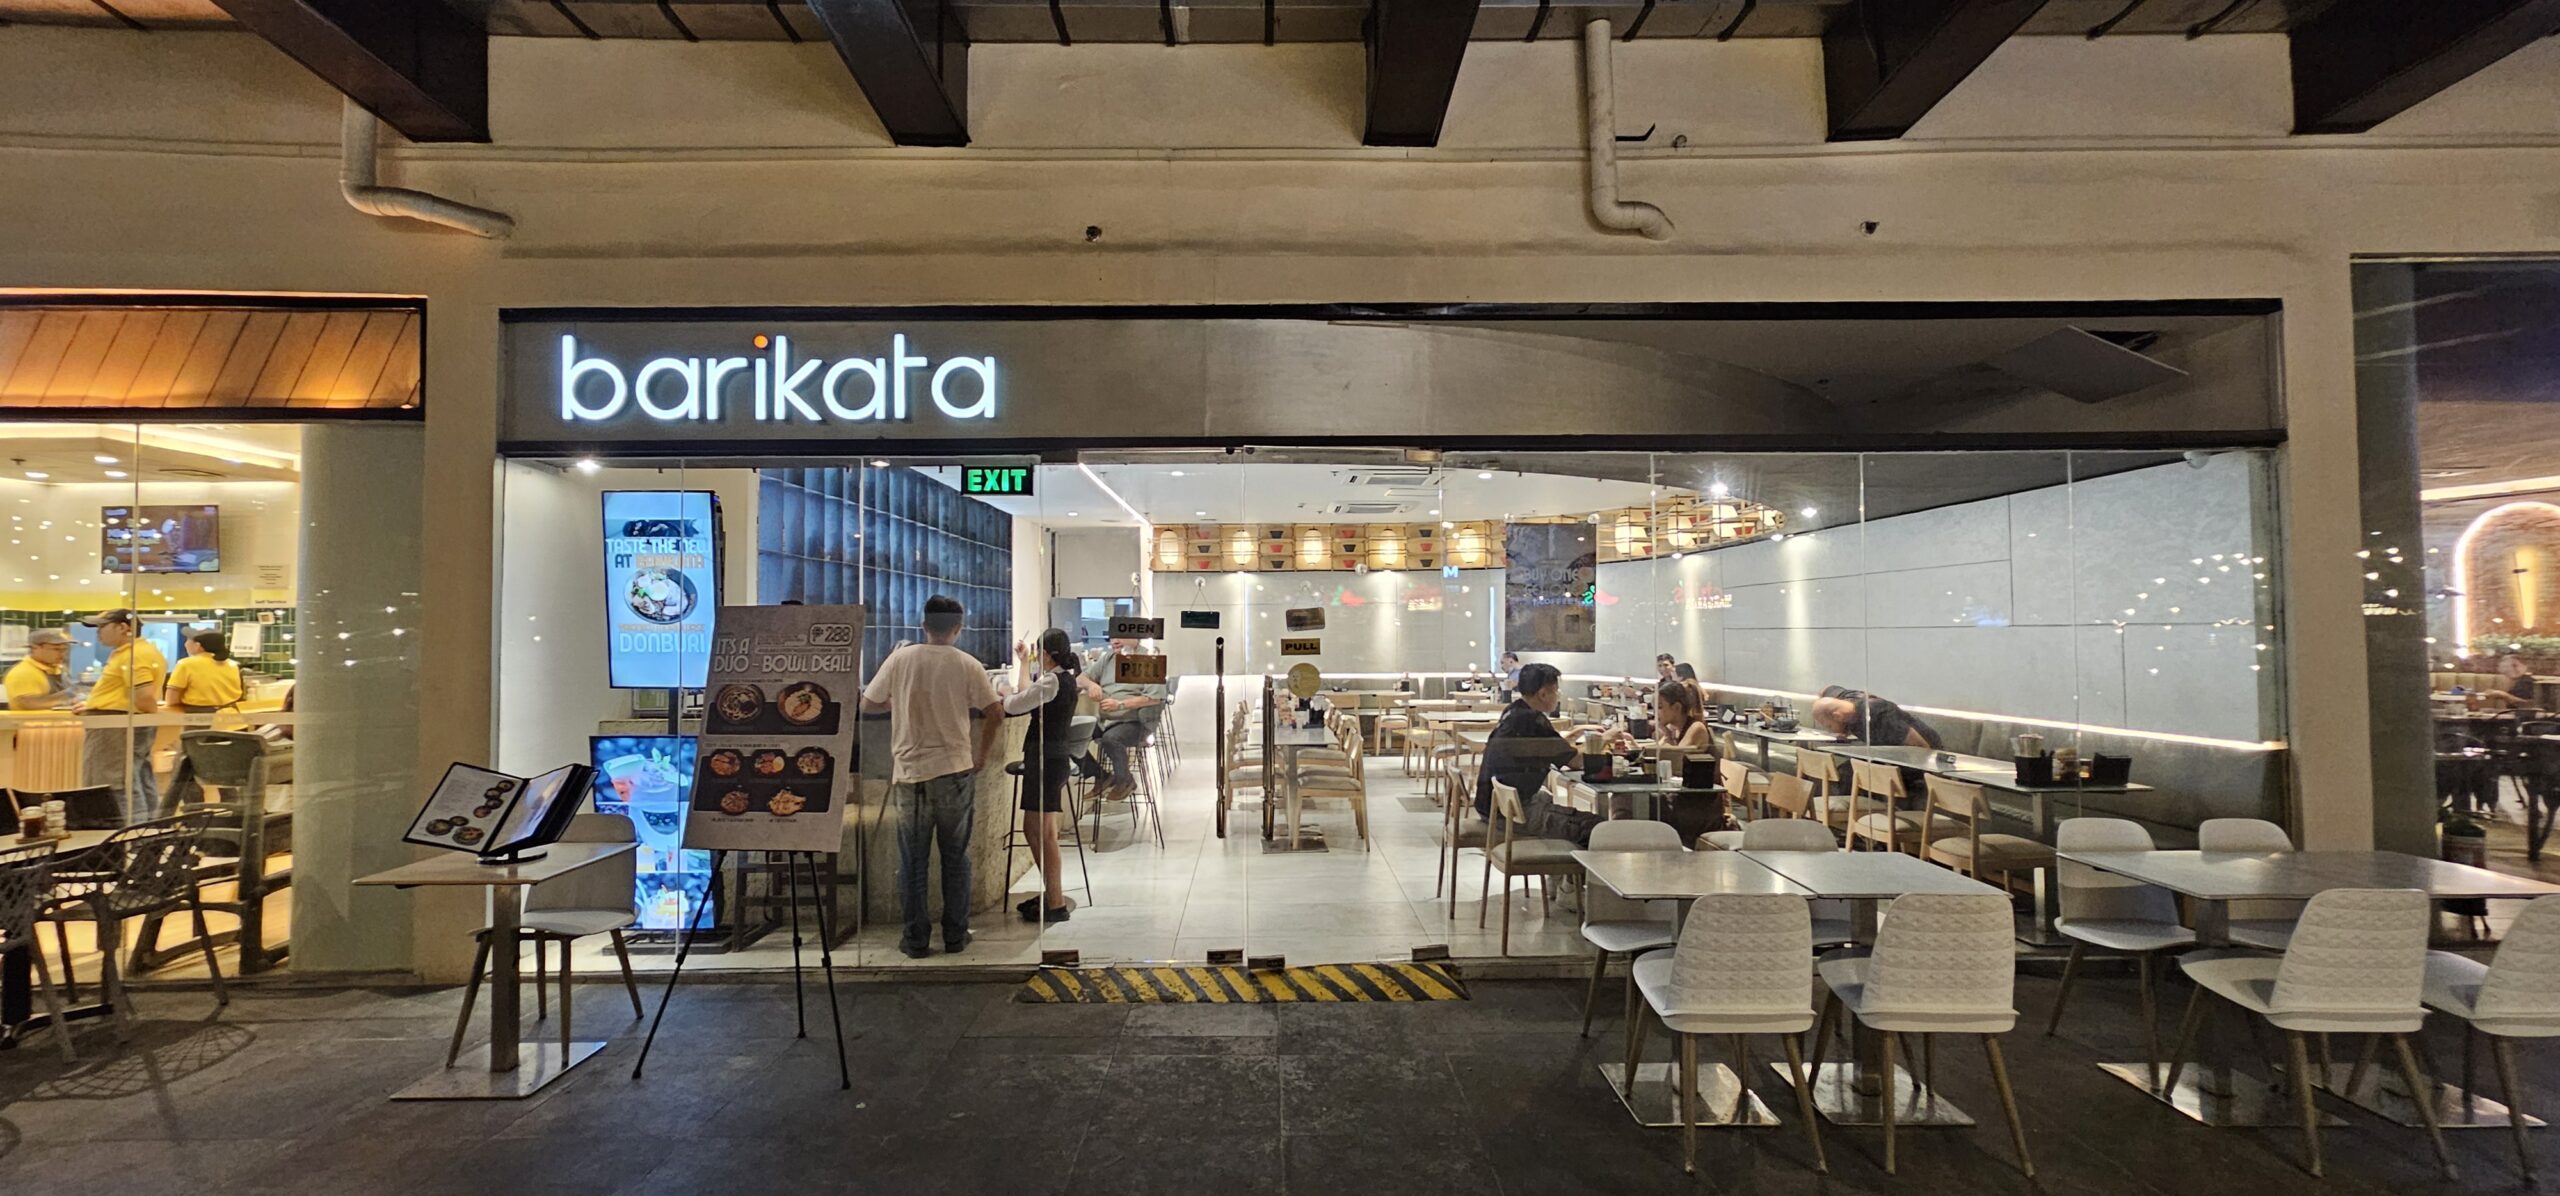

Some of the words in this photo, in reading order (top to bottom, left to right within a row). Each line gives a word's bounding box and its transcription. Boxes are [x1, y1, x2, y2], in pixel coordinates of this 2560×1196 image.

[562, 334, 995, 421] barikata
[967, 469, 1028, 491] EXIT
[606, 538, 647, 554] TASTE
[650, 538, 677, 554] THE
[615, 554, 632, 568] AT
[1118, 623, 1155, 634] OPEN
[620, 633, 705, 653] DONBURI
[716, 637, 737, 655] IT'S
[739, 637, 750, 655] A
[1284, 642, 1318, 651] PULL
[714, 655, 750, 673] DUO
[762, 655, 808, 673] BOWL
[810, 655, 851, 672] DEAL!
[1121, 662, 1160, 678] PULL
